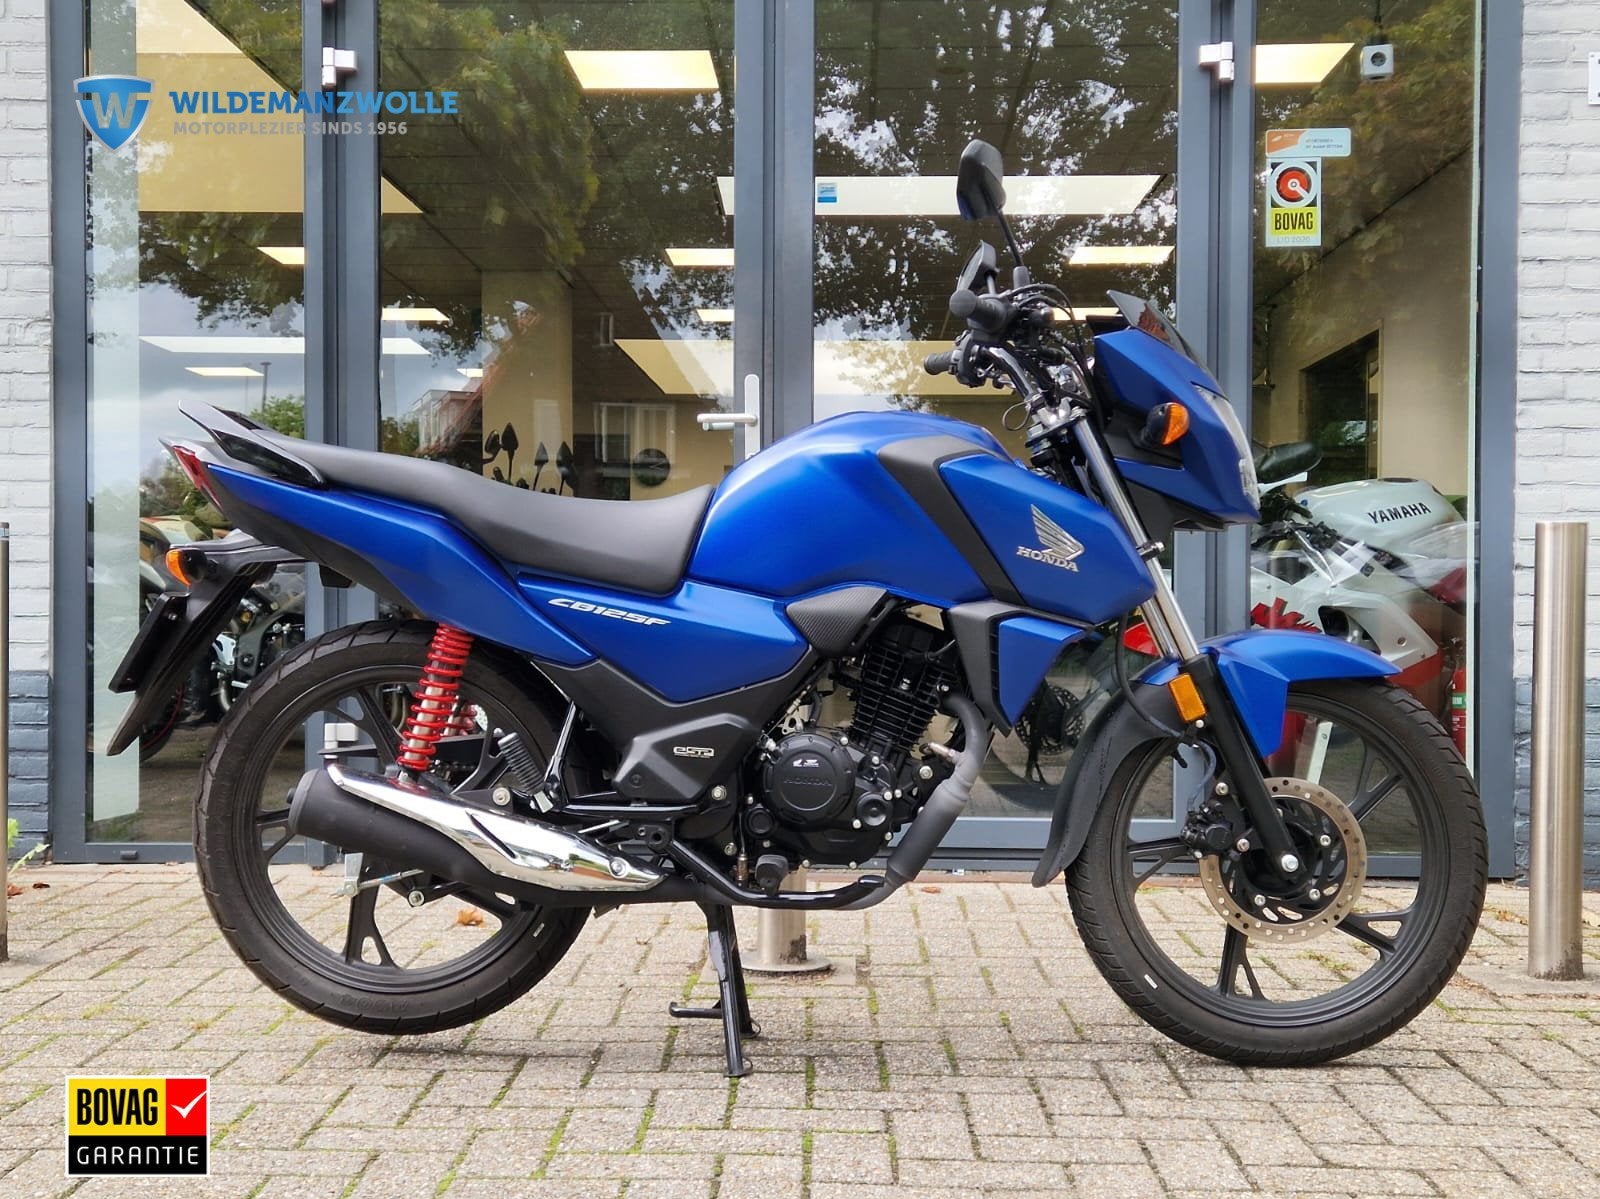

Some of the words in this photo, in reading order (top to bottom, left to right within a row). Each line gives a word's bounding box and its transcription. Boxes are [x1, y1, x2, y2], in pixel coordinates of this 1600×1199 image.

[1274, 212, 1314, 230] BOVAG
[1367, 502, 1432, 524] YAMAHA
[1016, 546, 1080, 572] HONDA
[548, 598, 672, 625] CB125F
